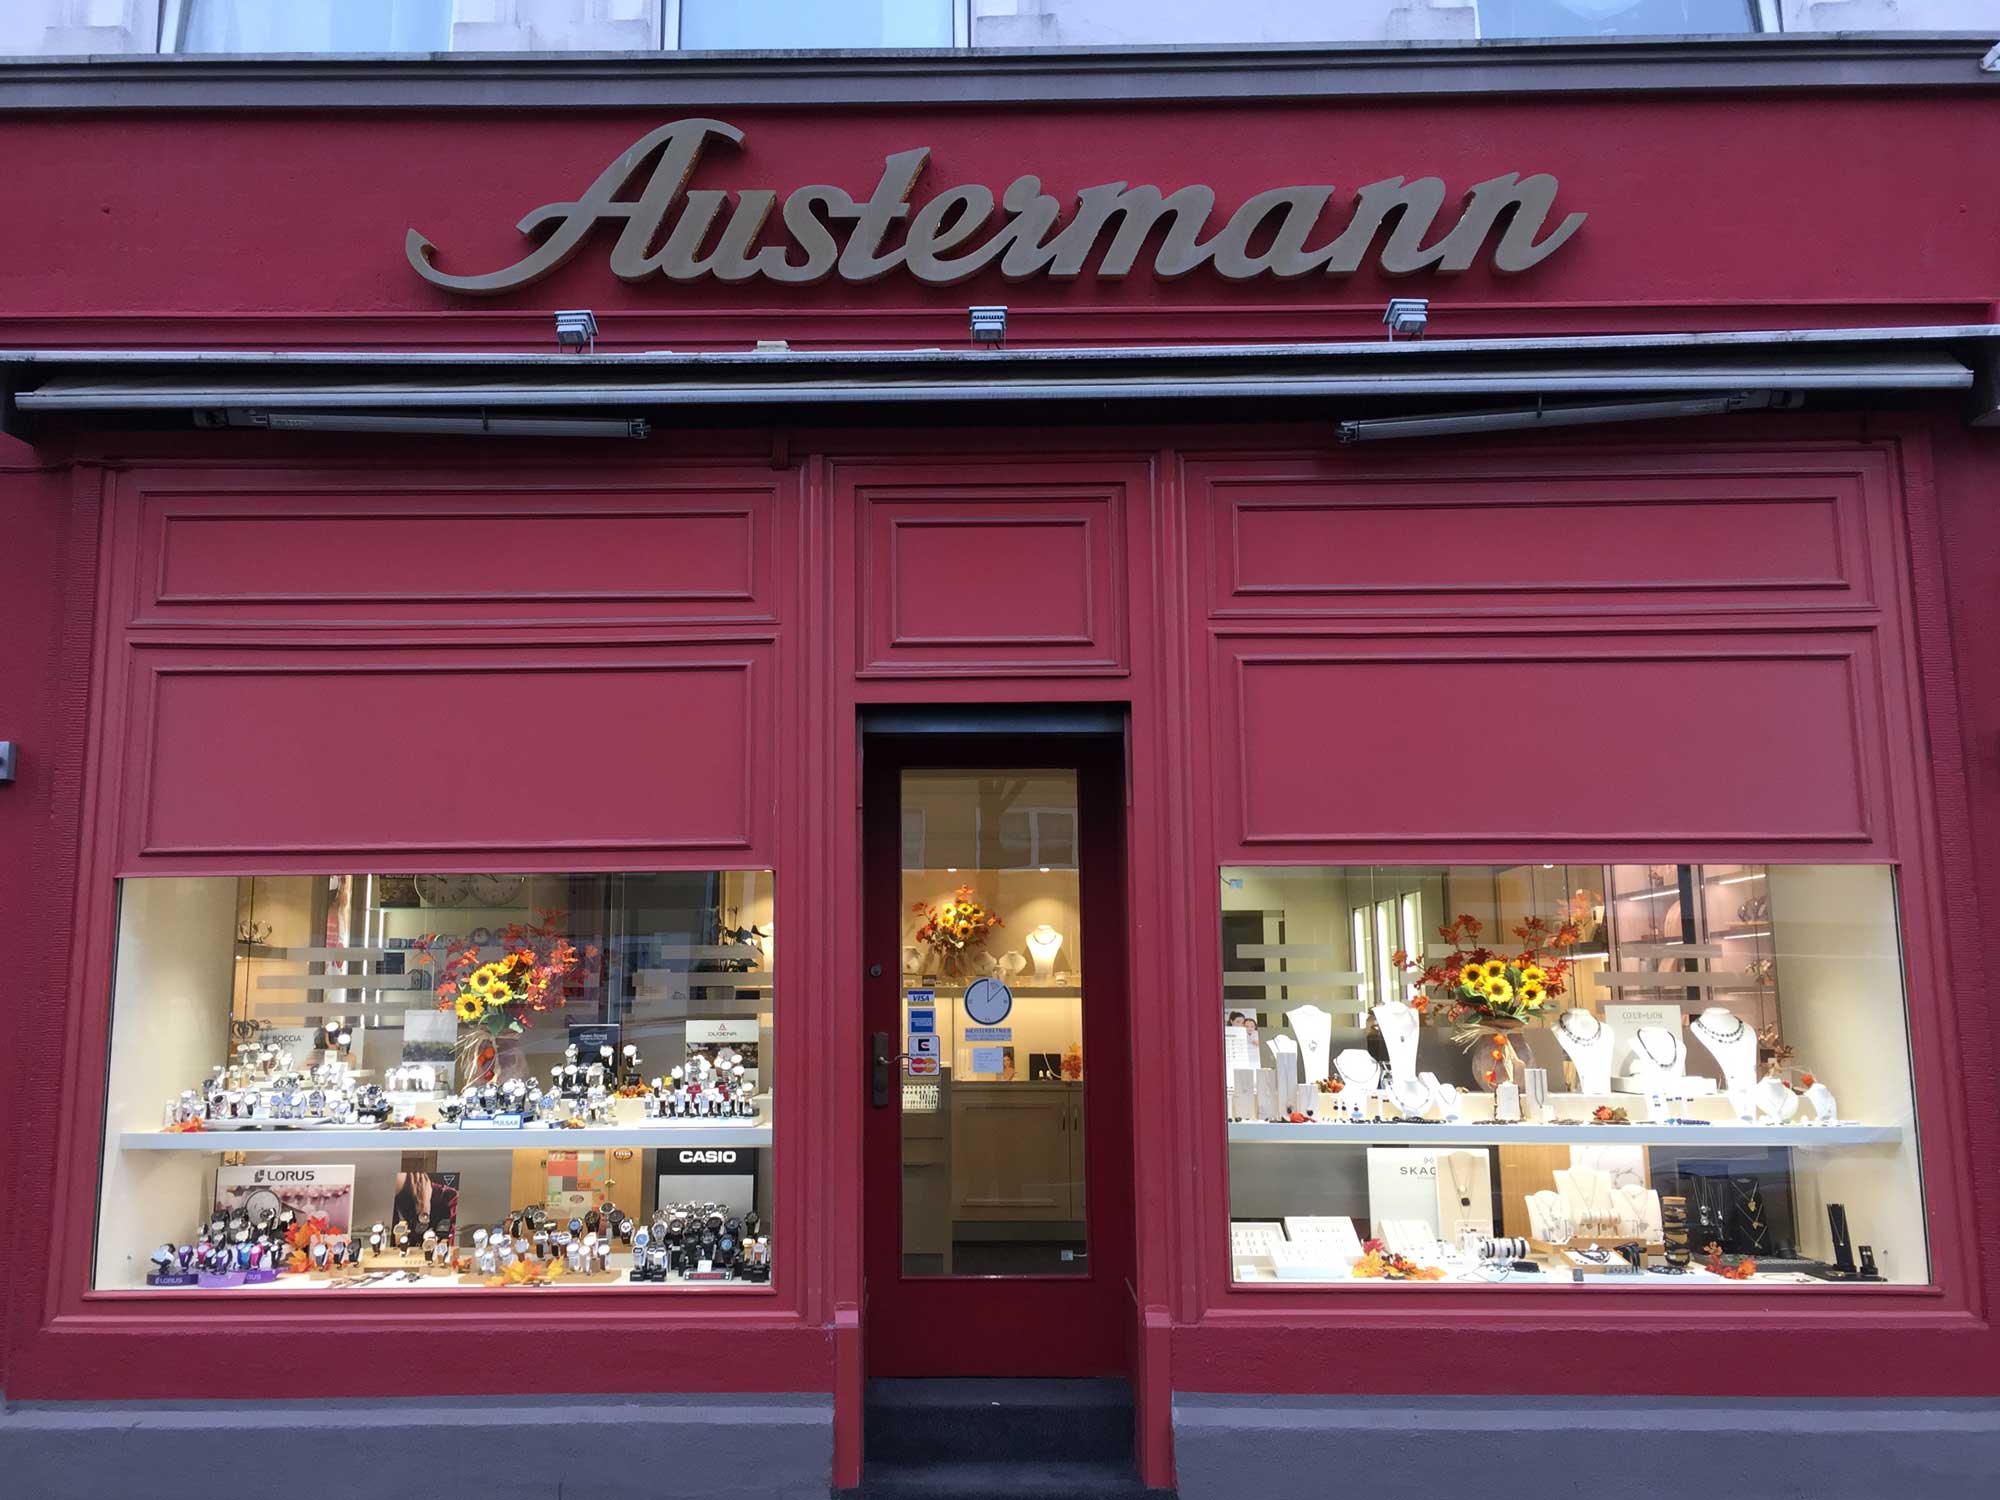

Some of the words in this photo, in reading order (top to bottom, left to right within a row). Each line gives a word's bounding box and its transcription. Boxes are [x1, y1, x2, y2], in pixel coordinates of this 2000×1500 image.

[404, 117, 1589, 292] Austermann
[679, 1150, 737, 1163] CASIO
[267, 1170, 315, 1182] LORUS
